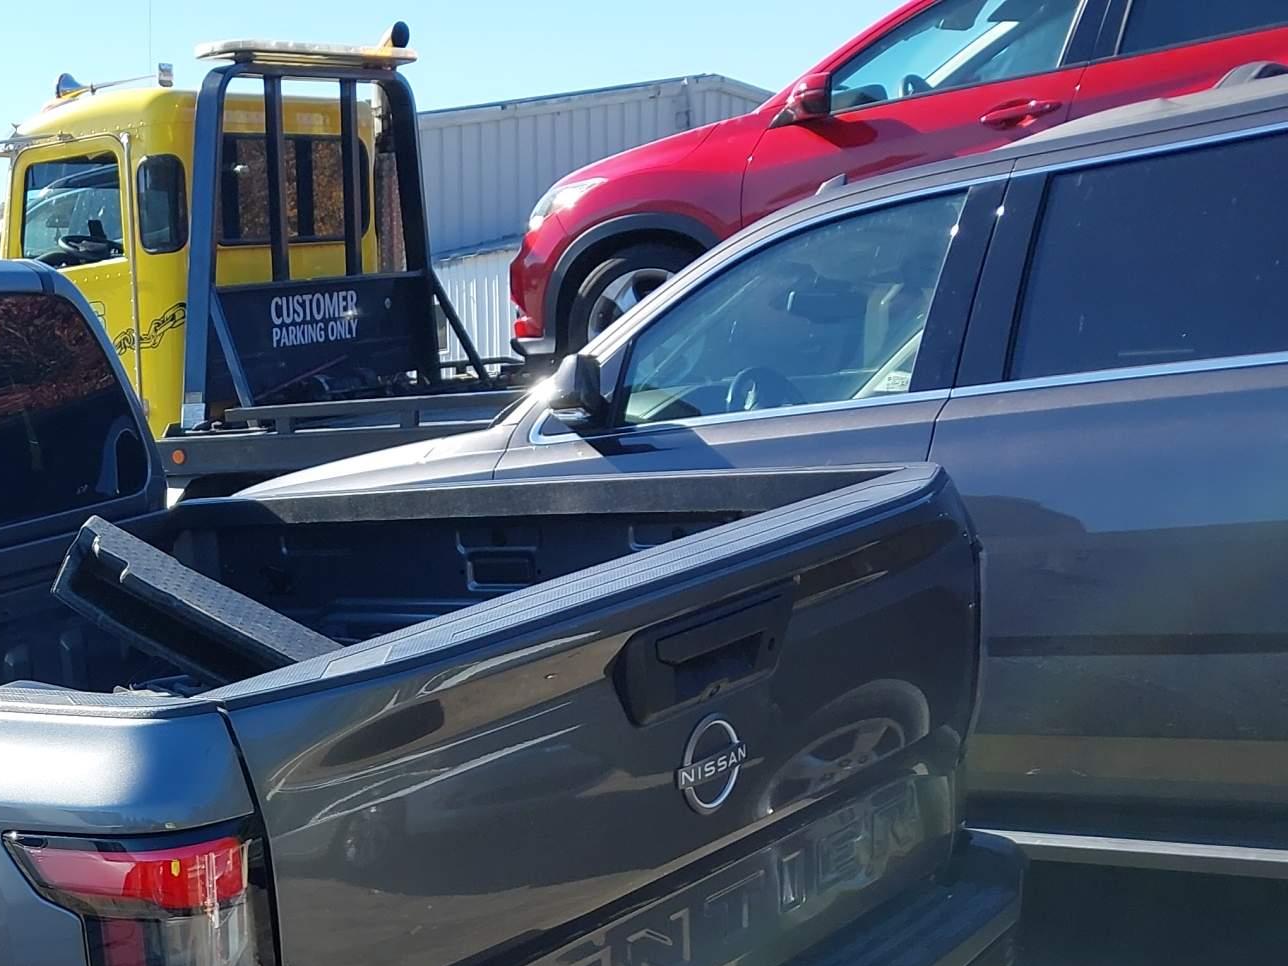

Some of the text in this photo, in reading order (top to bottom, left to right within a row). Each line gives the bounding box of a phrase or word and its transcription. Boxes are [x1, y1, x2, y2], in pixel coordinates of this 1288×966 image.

[270, 290, 358, 325] CUSTOMER
[272, 318, 358, 347] PARKING ONLY
[680, 743, 747, 786] NISSAN
